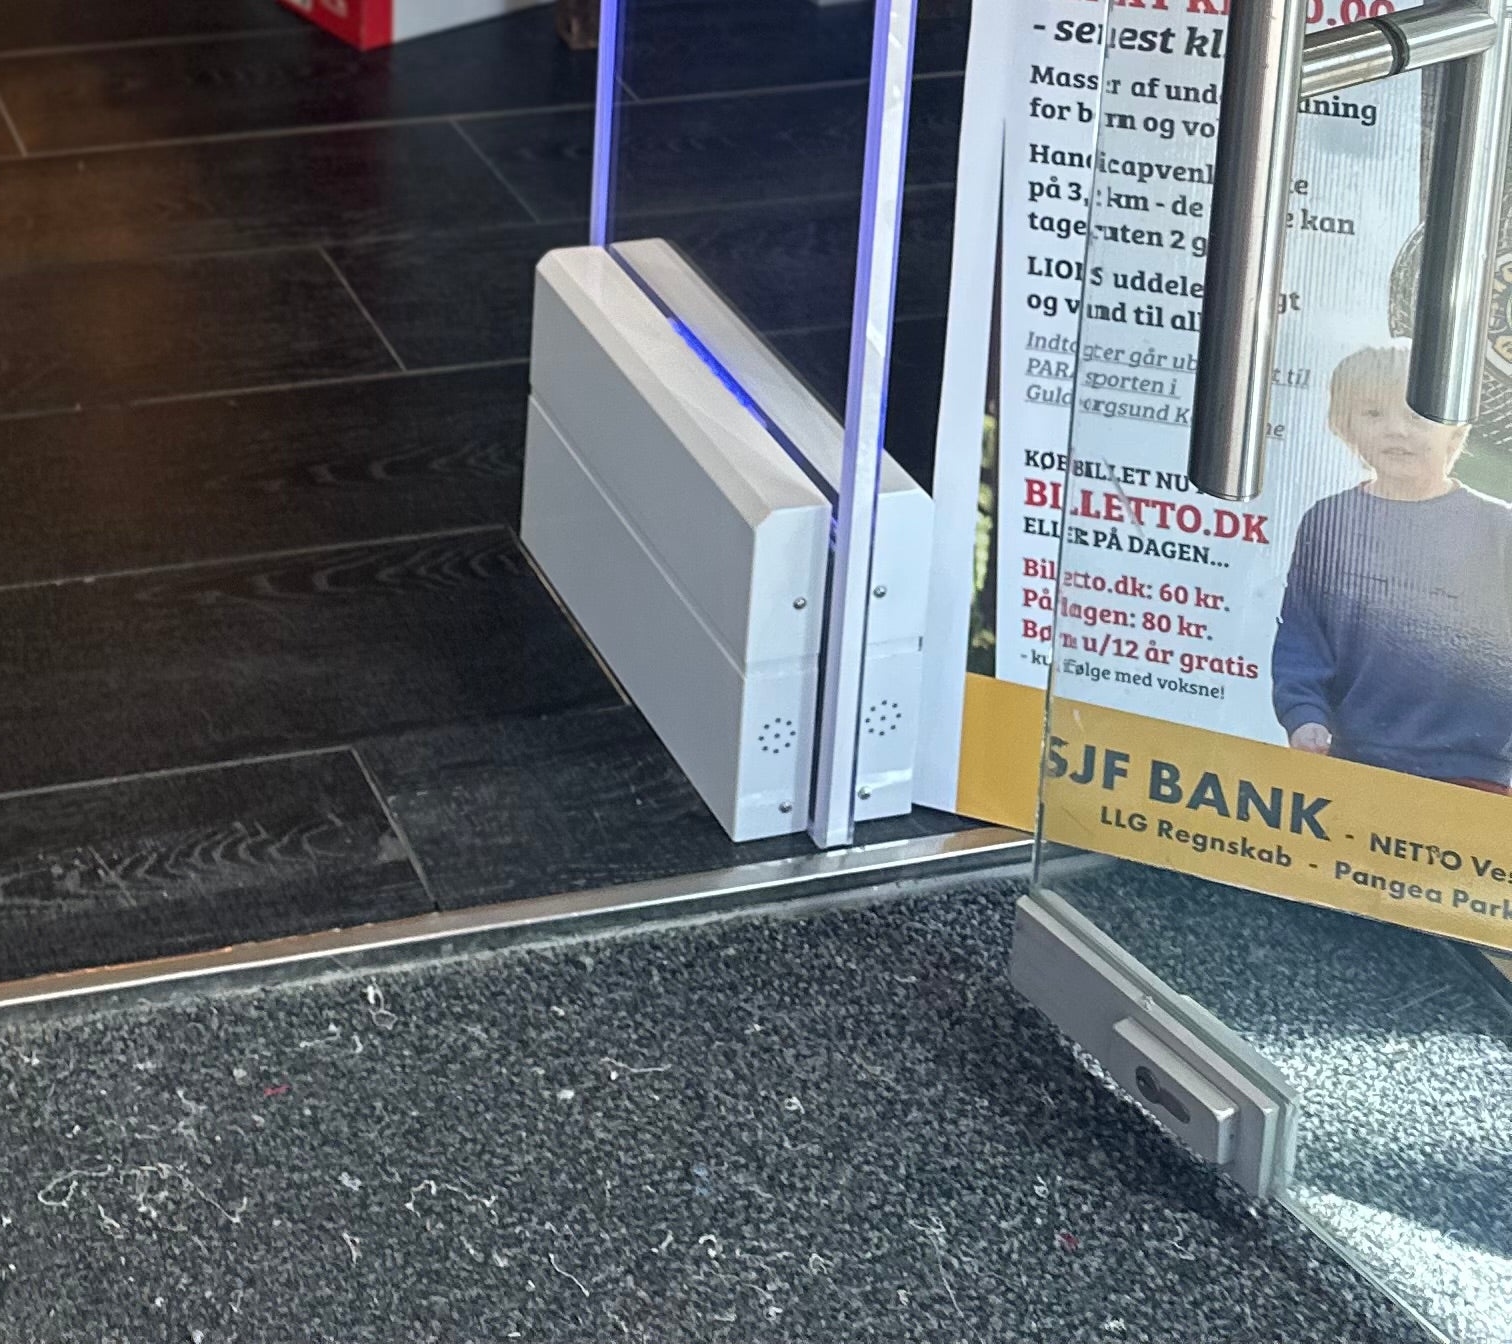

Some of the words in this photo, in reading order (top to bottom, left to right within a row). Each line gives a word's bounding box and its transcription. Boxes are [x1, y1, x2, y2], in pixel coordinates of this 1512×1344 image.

[1131, 78, 1160, 99] af
[1029, 97, 1071, 120] for
[1077, 102, 1137, 130] brn
[1143, 115, 1175, 139] og
[1029, 176, 1061, 201] på
[1107, 187, 1149, 212] km
[1300, 208, 1355, 235] kan
[1028, 212, 1087, 239] tage
[1170, 230, 1186, 250] 2
[1027, 293, 1058, 317] og
[1134, 305, 1164, 329] til
[1129, 347, 1168, 368] går
[1170, 379, 1177, 396] i
[1155, 472, 1189, 493] NU
[1024, 516, 1089, 546] ELLR
[1093, 527, 1124, 552] PÅ
[1022, 588, 1053, 610] På
[1142, 611, 1172, 634] 80
[1177, 615, 1214, 641] kr.
[1159, 583, 1189, 605] 60
[1194, 587, 1231, 613] kr.
[1082, 634, 1139, 659] u/12
[1144, 640, 1174, 665] år
[1179, 653, 1259, 680] gratis
[1115, 670, 1153, 688] med
[1157, 677, 1226, 700] voksne!
[1148, 759, 1334, 842] BANK
[1370, 831, 1462, 871] NETTO
[1100, 805, 1148, 832] LLG
[1157, 818, 1292, 868] Regnskab
[1335, 859, 1443, 904] Pangea
